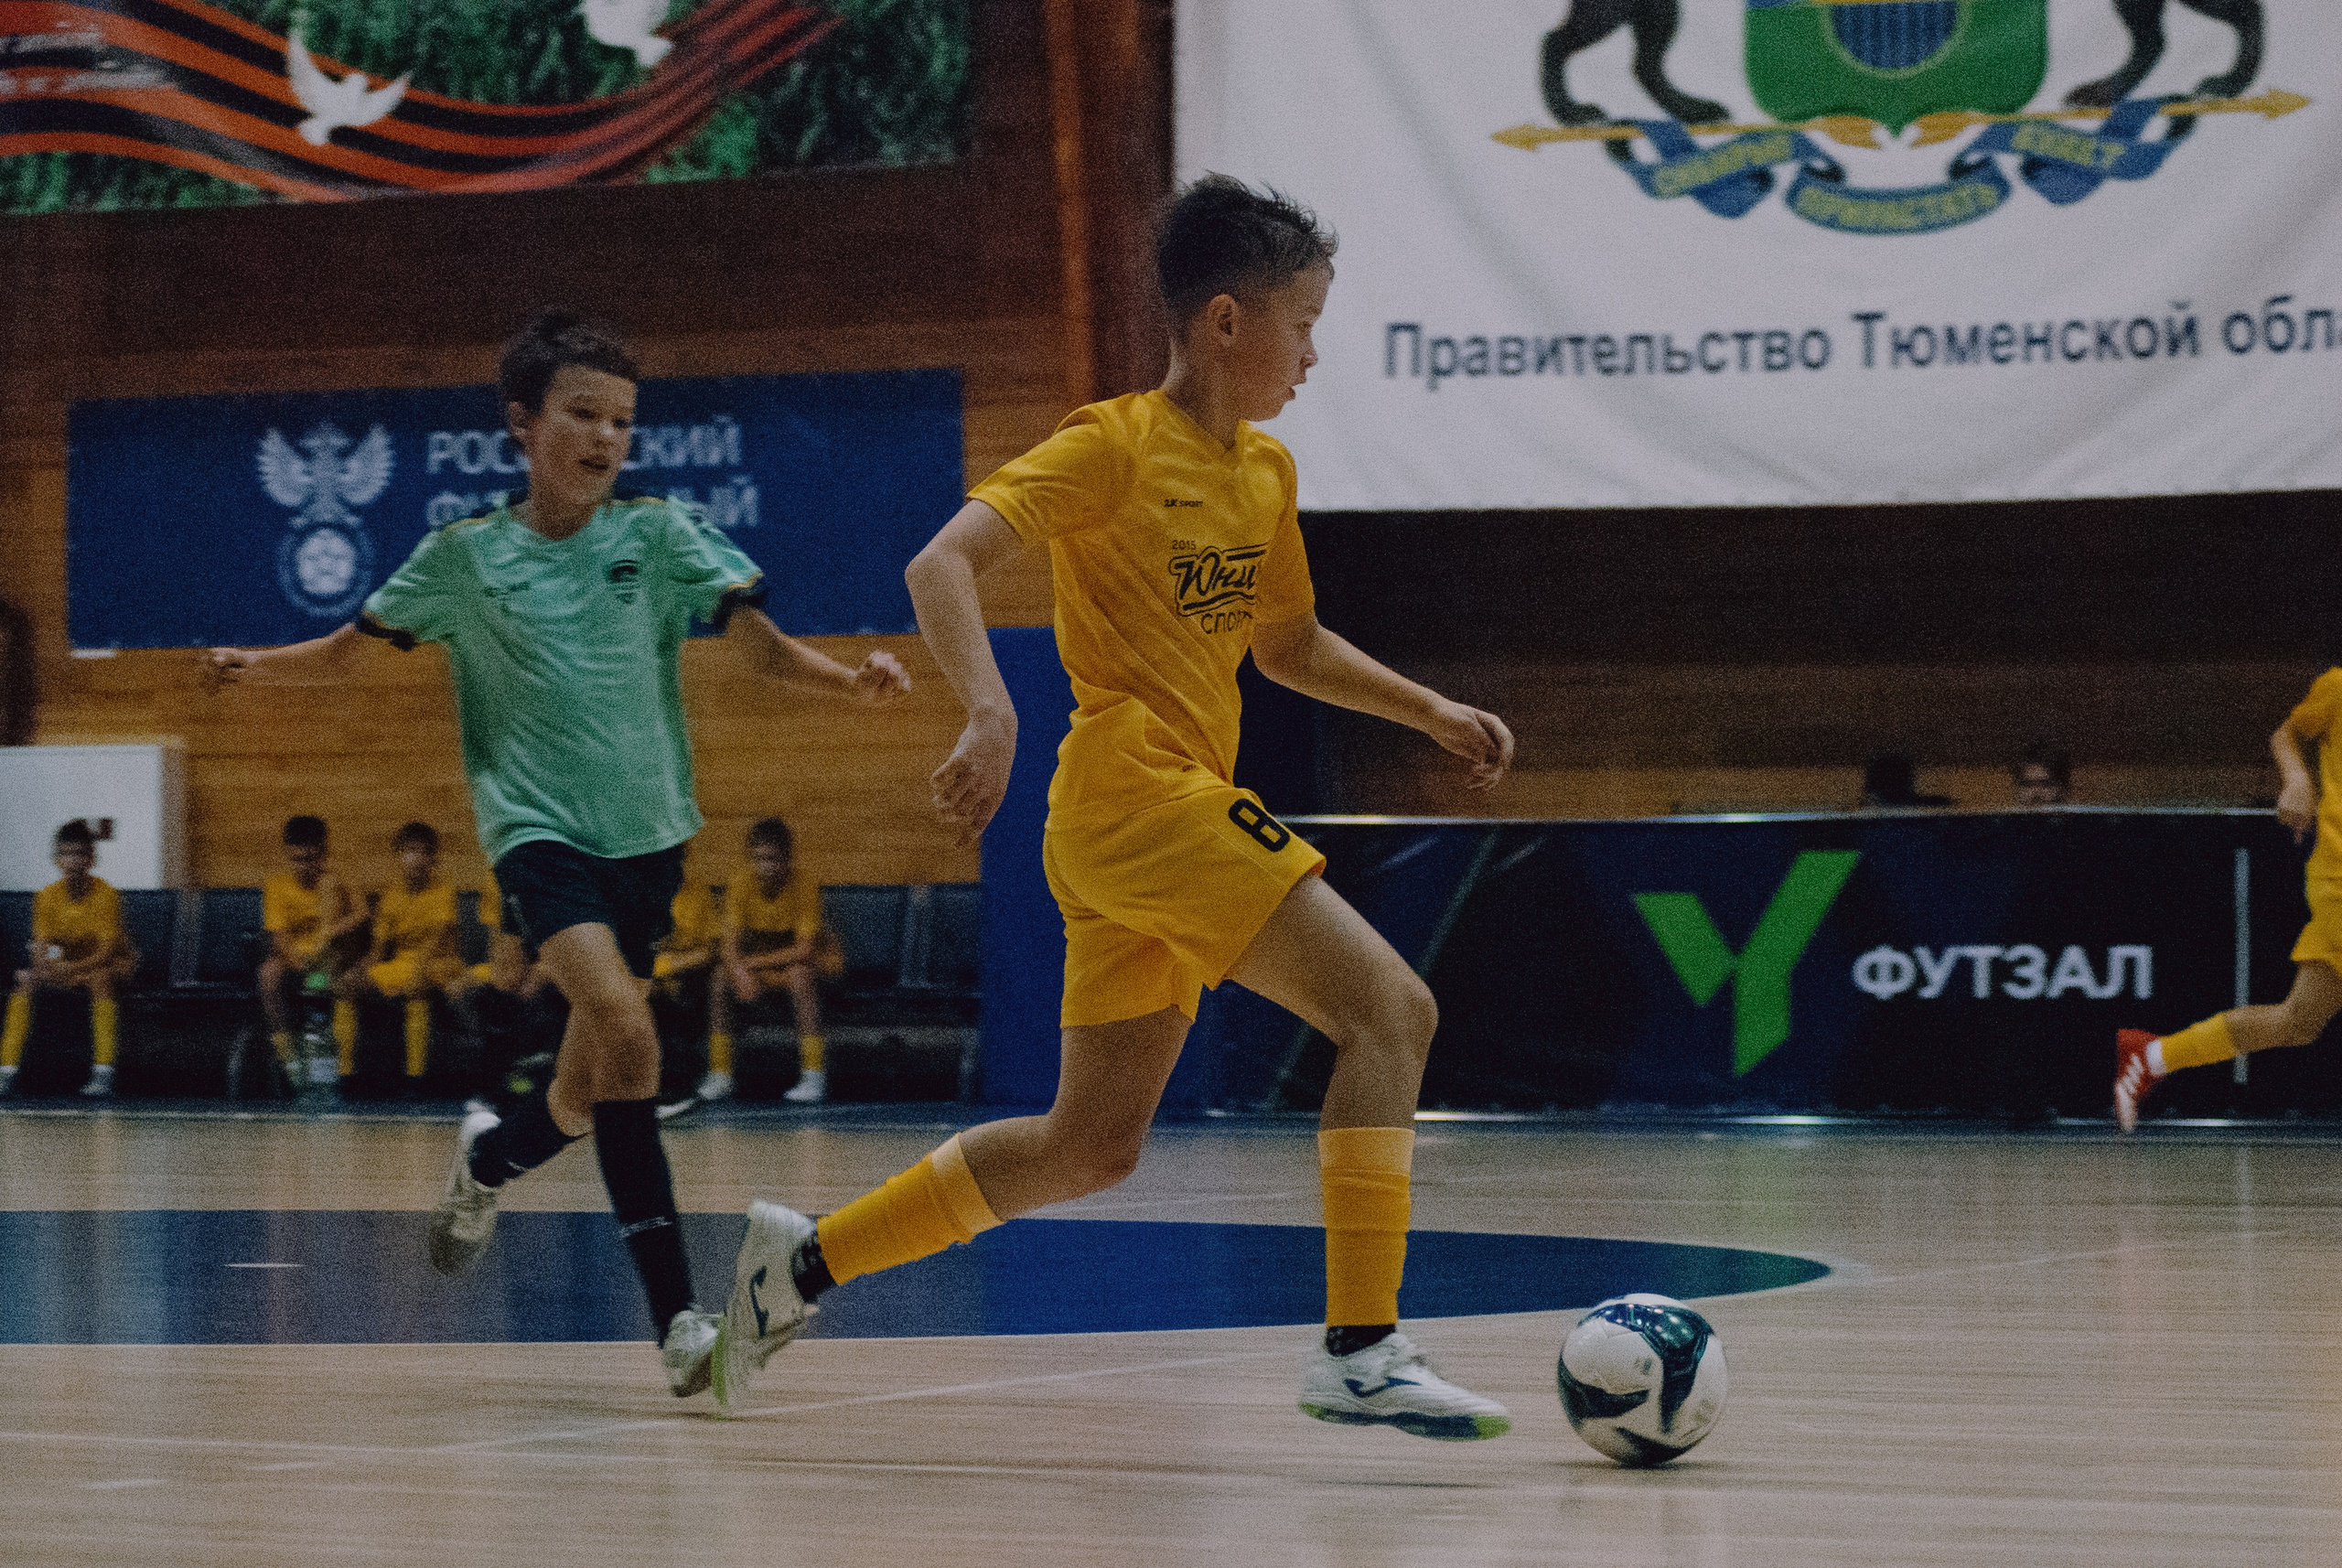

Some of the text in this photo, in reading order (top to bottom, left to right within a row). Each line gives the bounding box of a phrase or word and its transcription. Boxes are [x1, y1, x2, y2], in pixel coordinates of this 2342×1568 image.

[1386, 293, 2342, 388] Правительство Тюменской обл
[1171, 539, 1197, 550] 2015
[1228, 798, 1291, 853] 8
[1852, 944, 2154, 1000] ФУТЗАЛ
